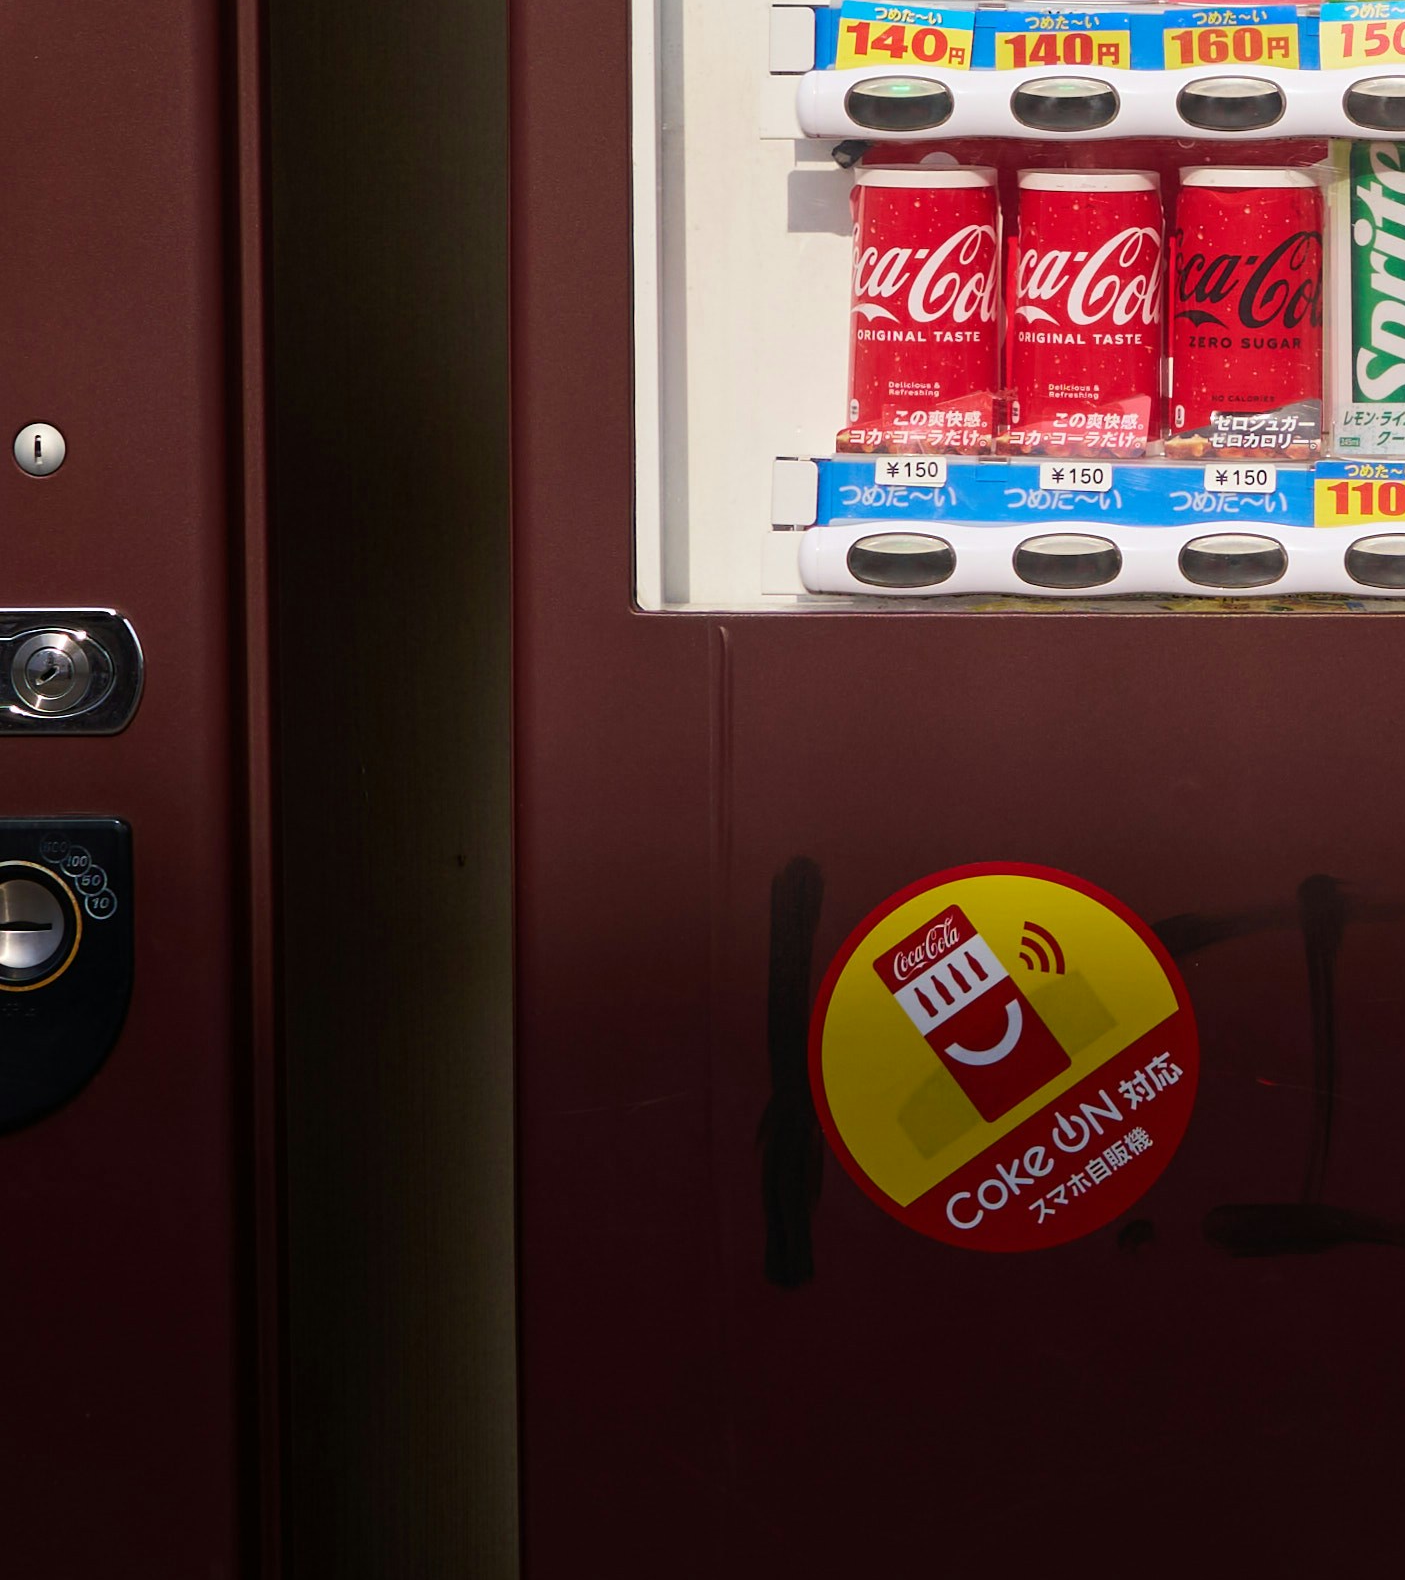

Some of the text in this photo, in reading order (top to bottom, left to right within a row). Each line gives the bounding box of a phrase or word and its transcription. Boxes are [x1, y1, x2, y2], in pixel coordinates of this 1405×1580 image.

[847, 23, 964, 65] 140円
[1171, 31, 1290, 63] 160円
[1215, 415, 1314, 432] ゼロシュガー
[92, 897, 109, 909] 10
[946, 1052, 1183, 1229] Coke ON 対応
[1029, 1127, 1153, 1224] スマホ自販機
